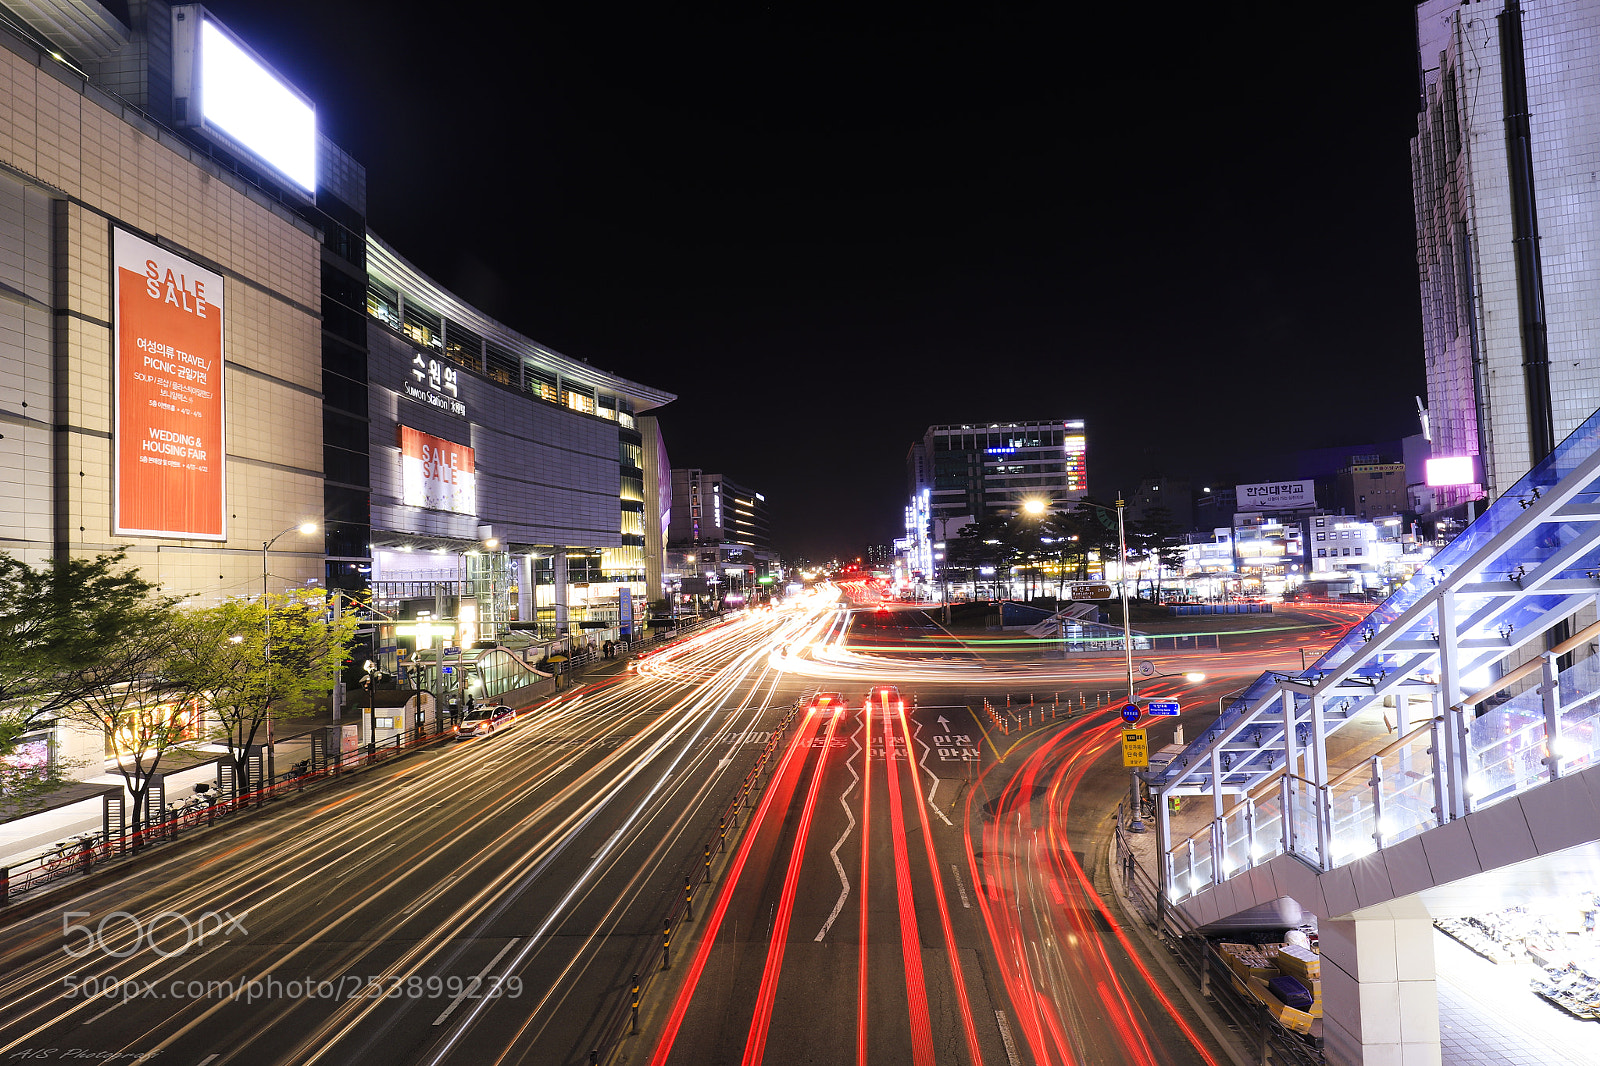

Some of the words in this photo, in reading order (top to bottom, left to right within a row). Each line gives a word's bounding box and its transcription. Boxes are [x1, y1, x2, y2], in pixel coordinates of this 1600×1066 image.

[145, 259, 206, 300] SALE
[146, 279, 207, 319] SALE
[137, 337, 175, 360] 여성의류
[133, 371, 154, 383] SOUP
[144, 356, 177, 375] PICNIC
[177, 365, 207, 385] 균일가전
[412, 353, 457, 398] 수원역
[404, 380, 426, 401] Suwon
[426, 390, 448, 410] Station
[149, 427, 195, 446] WEDDING
[195, 437, 202, 448] &
[142, 440, 187, 458] HOUSING
[187, 448, 207, 461] FAIR
[422, 444, 458, 470] SALE
[422, 461, 458, 485] SALE
[1246, 484, 1305, 497] 한신대학교
[932, 734, 974, 747] 인천
[938, 747, 982, 761] 안산
